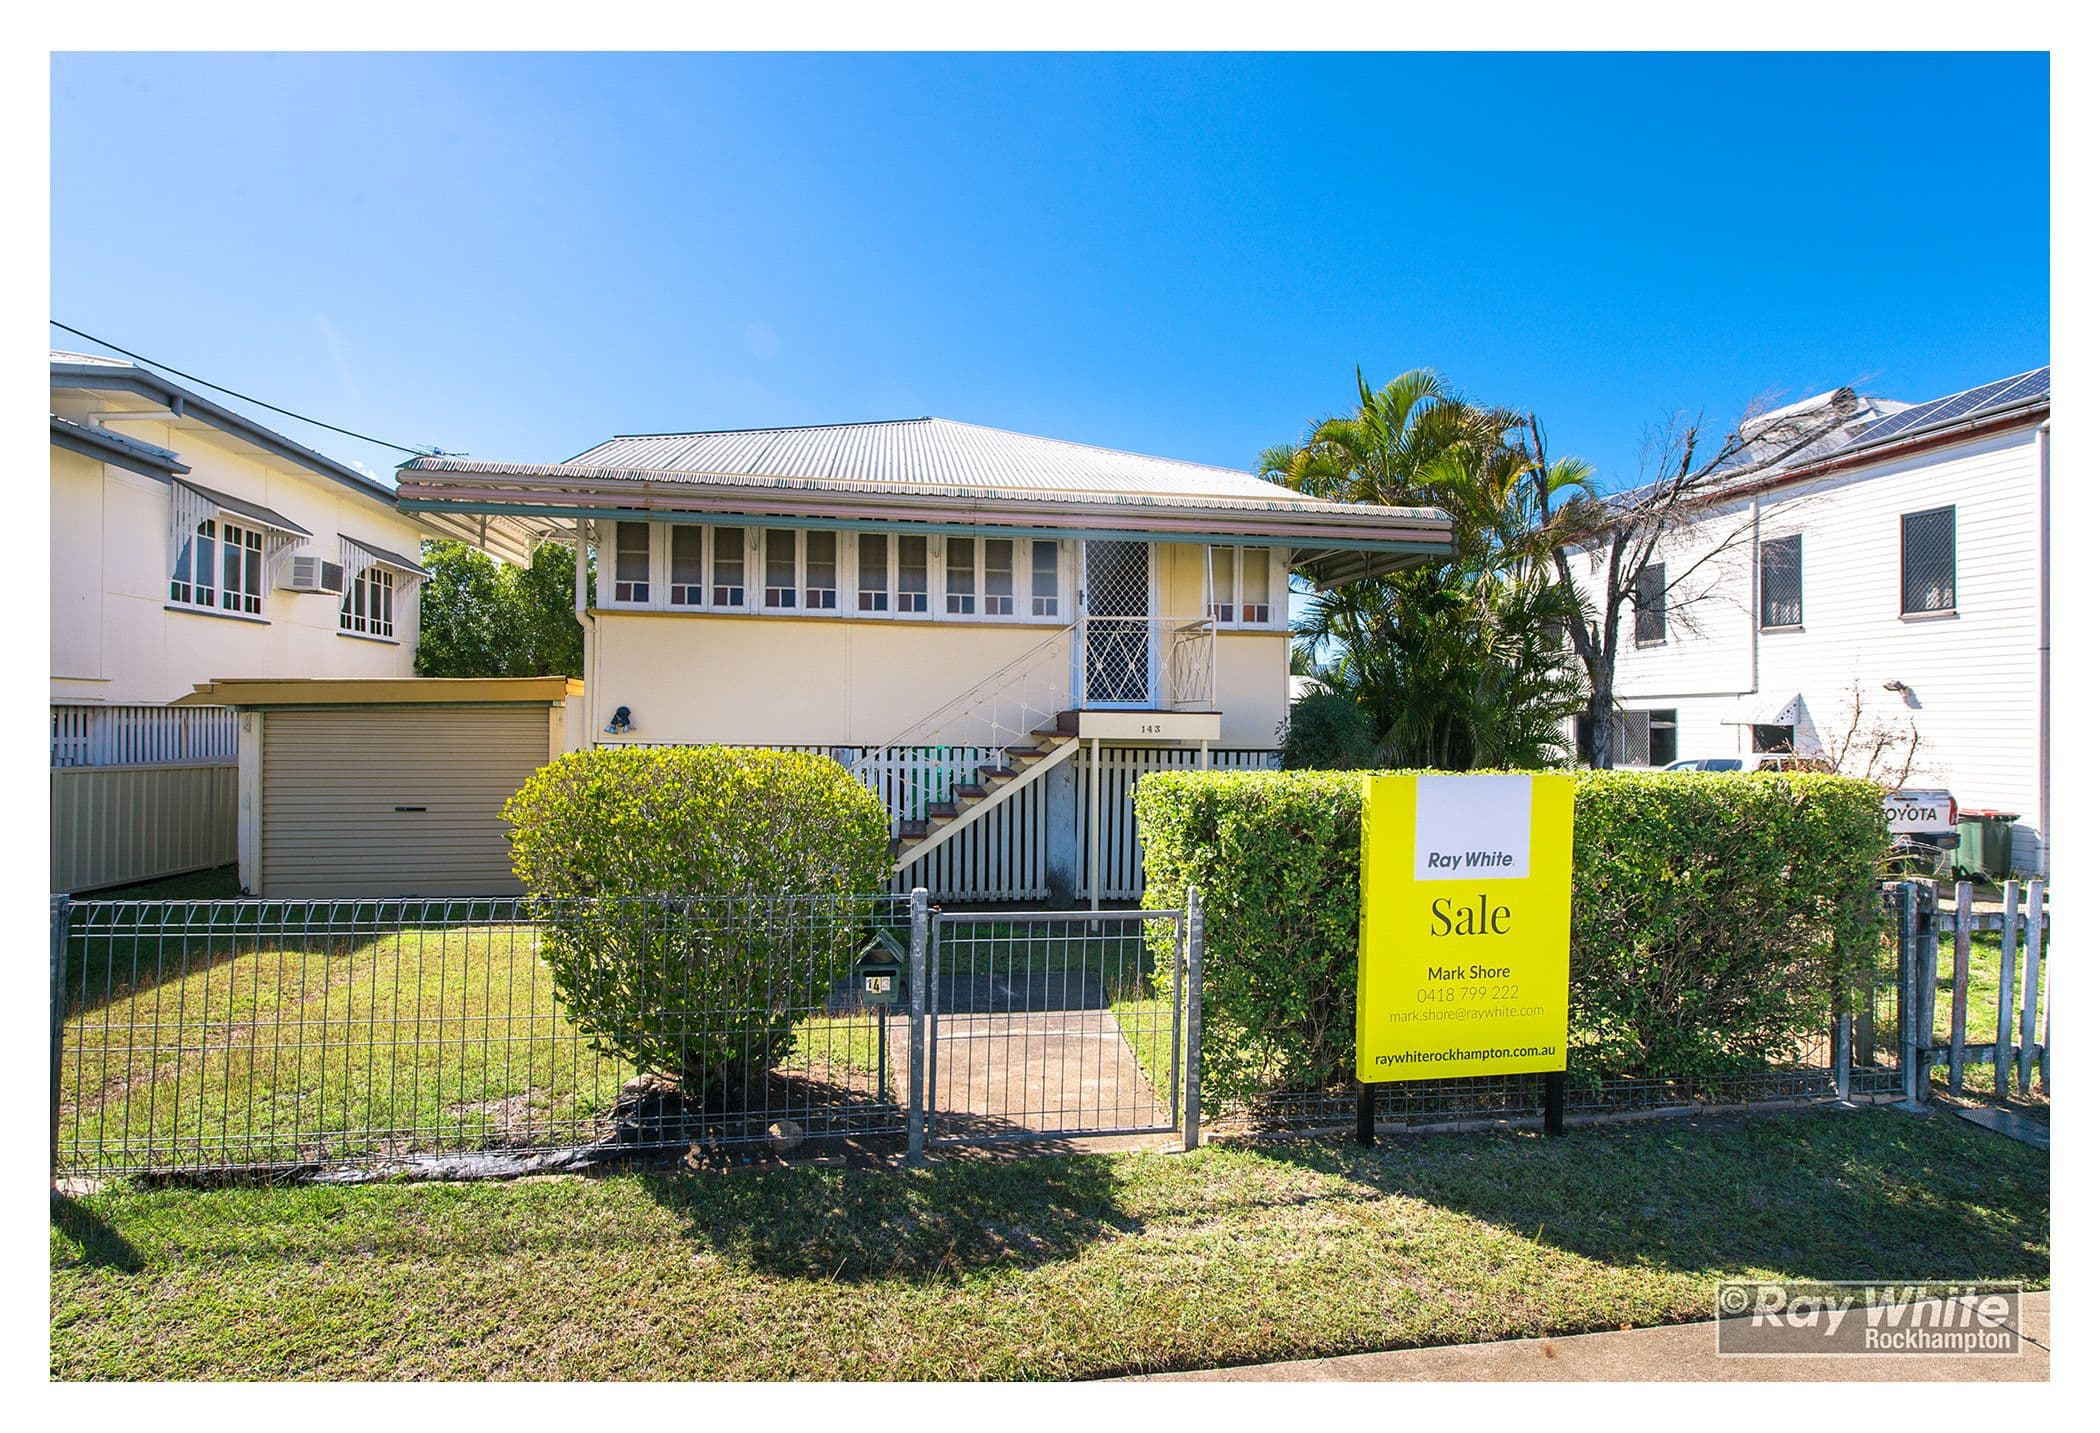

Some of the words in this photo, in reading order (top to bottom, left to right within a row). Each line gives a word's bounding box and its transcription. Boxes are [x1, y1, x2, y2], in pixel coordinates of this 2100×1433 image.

[1142, 725, 1161, 733] 143
[1886, 808, 1936, 821] OYOTA
[1428, 852, 1462, 871] Ray
[1465, 851, 1513, 867] White
[1431, 894, 1511, 937] Sale
[1428, 967, 1465, 981] Mark
[1469, 965, 1511, 979] Shore
[1417, 987, 1455, 1003] 0418
[1460, 986, 1487, 1001] 799
[1491, 984, 1519, 1000] 222
[1390, 1004, 1545, 1023] mark.shore@raywhite.com
[1375, 1046, 1556, 1067] raywhiterockhampton.com.au
